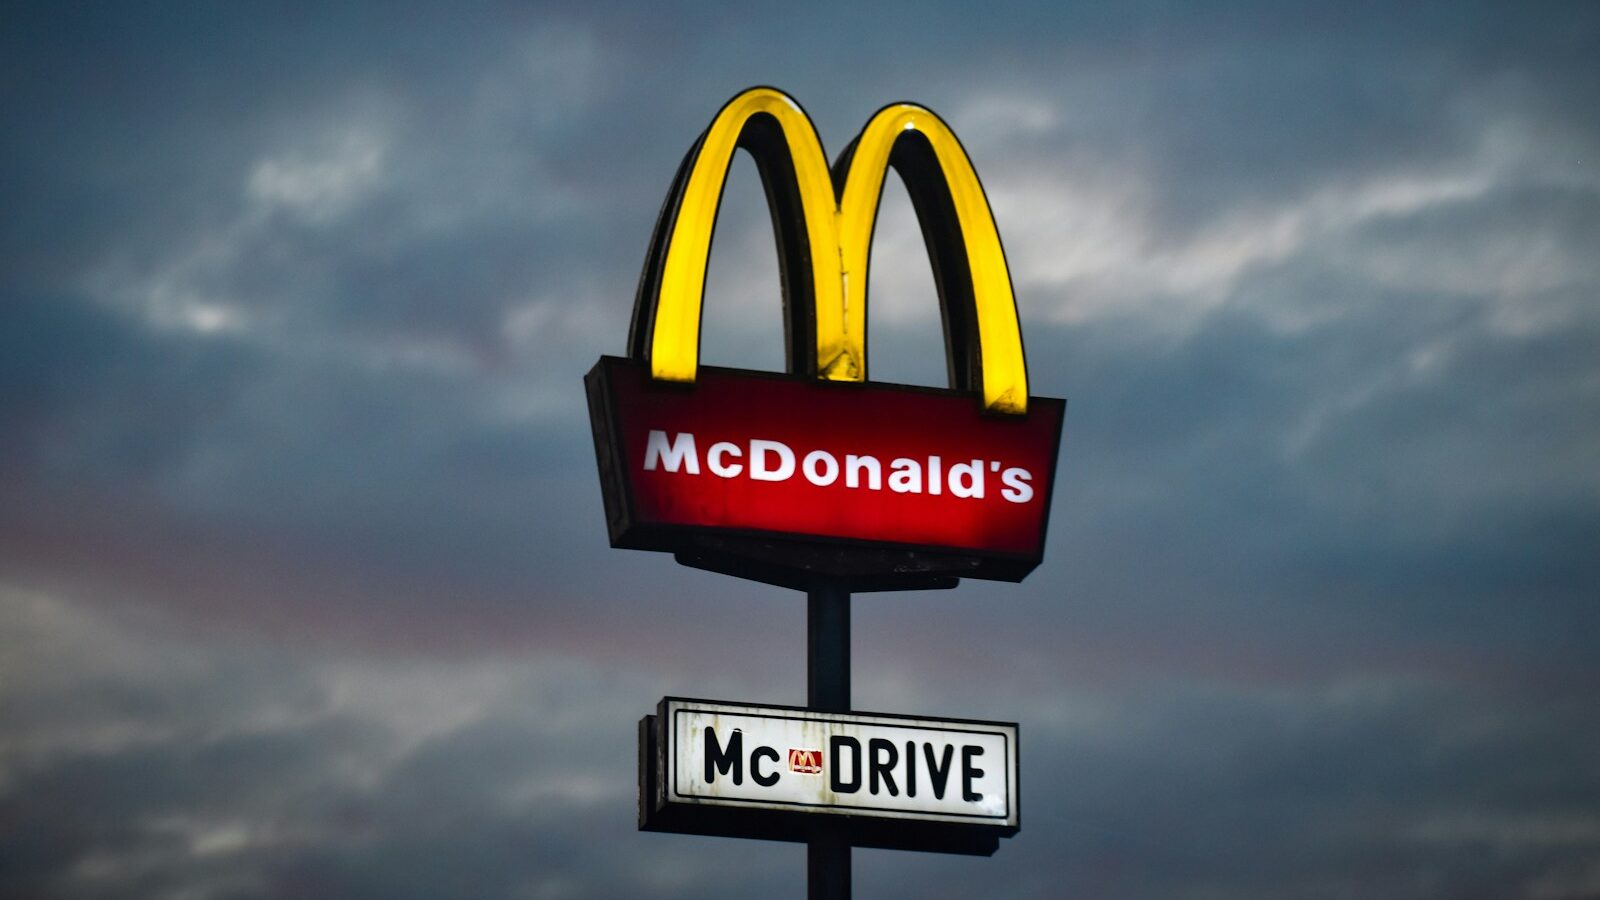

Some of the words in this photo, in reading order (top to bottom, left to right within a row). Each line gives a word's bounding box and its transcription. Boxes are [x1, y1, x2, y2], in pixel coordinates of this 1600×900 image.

[643, 429, 1034, 504] McDonald's
[704, 726, 781, 787] Mc
[829, 735, 985, 802] DRIVE
